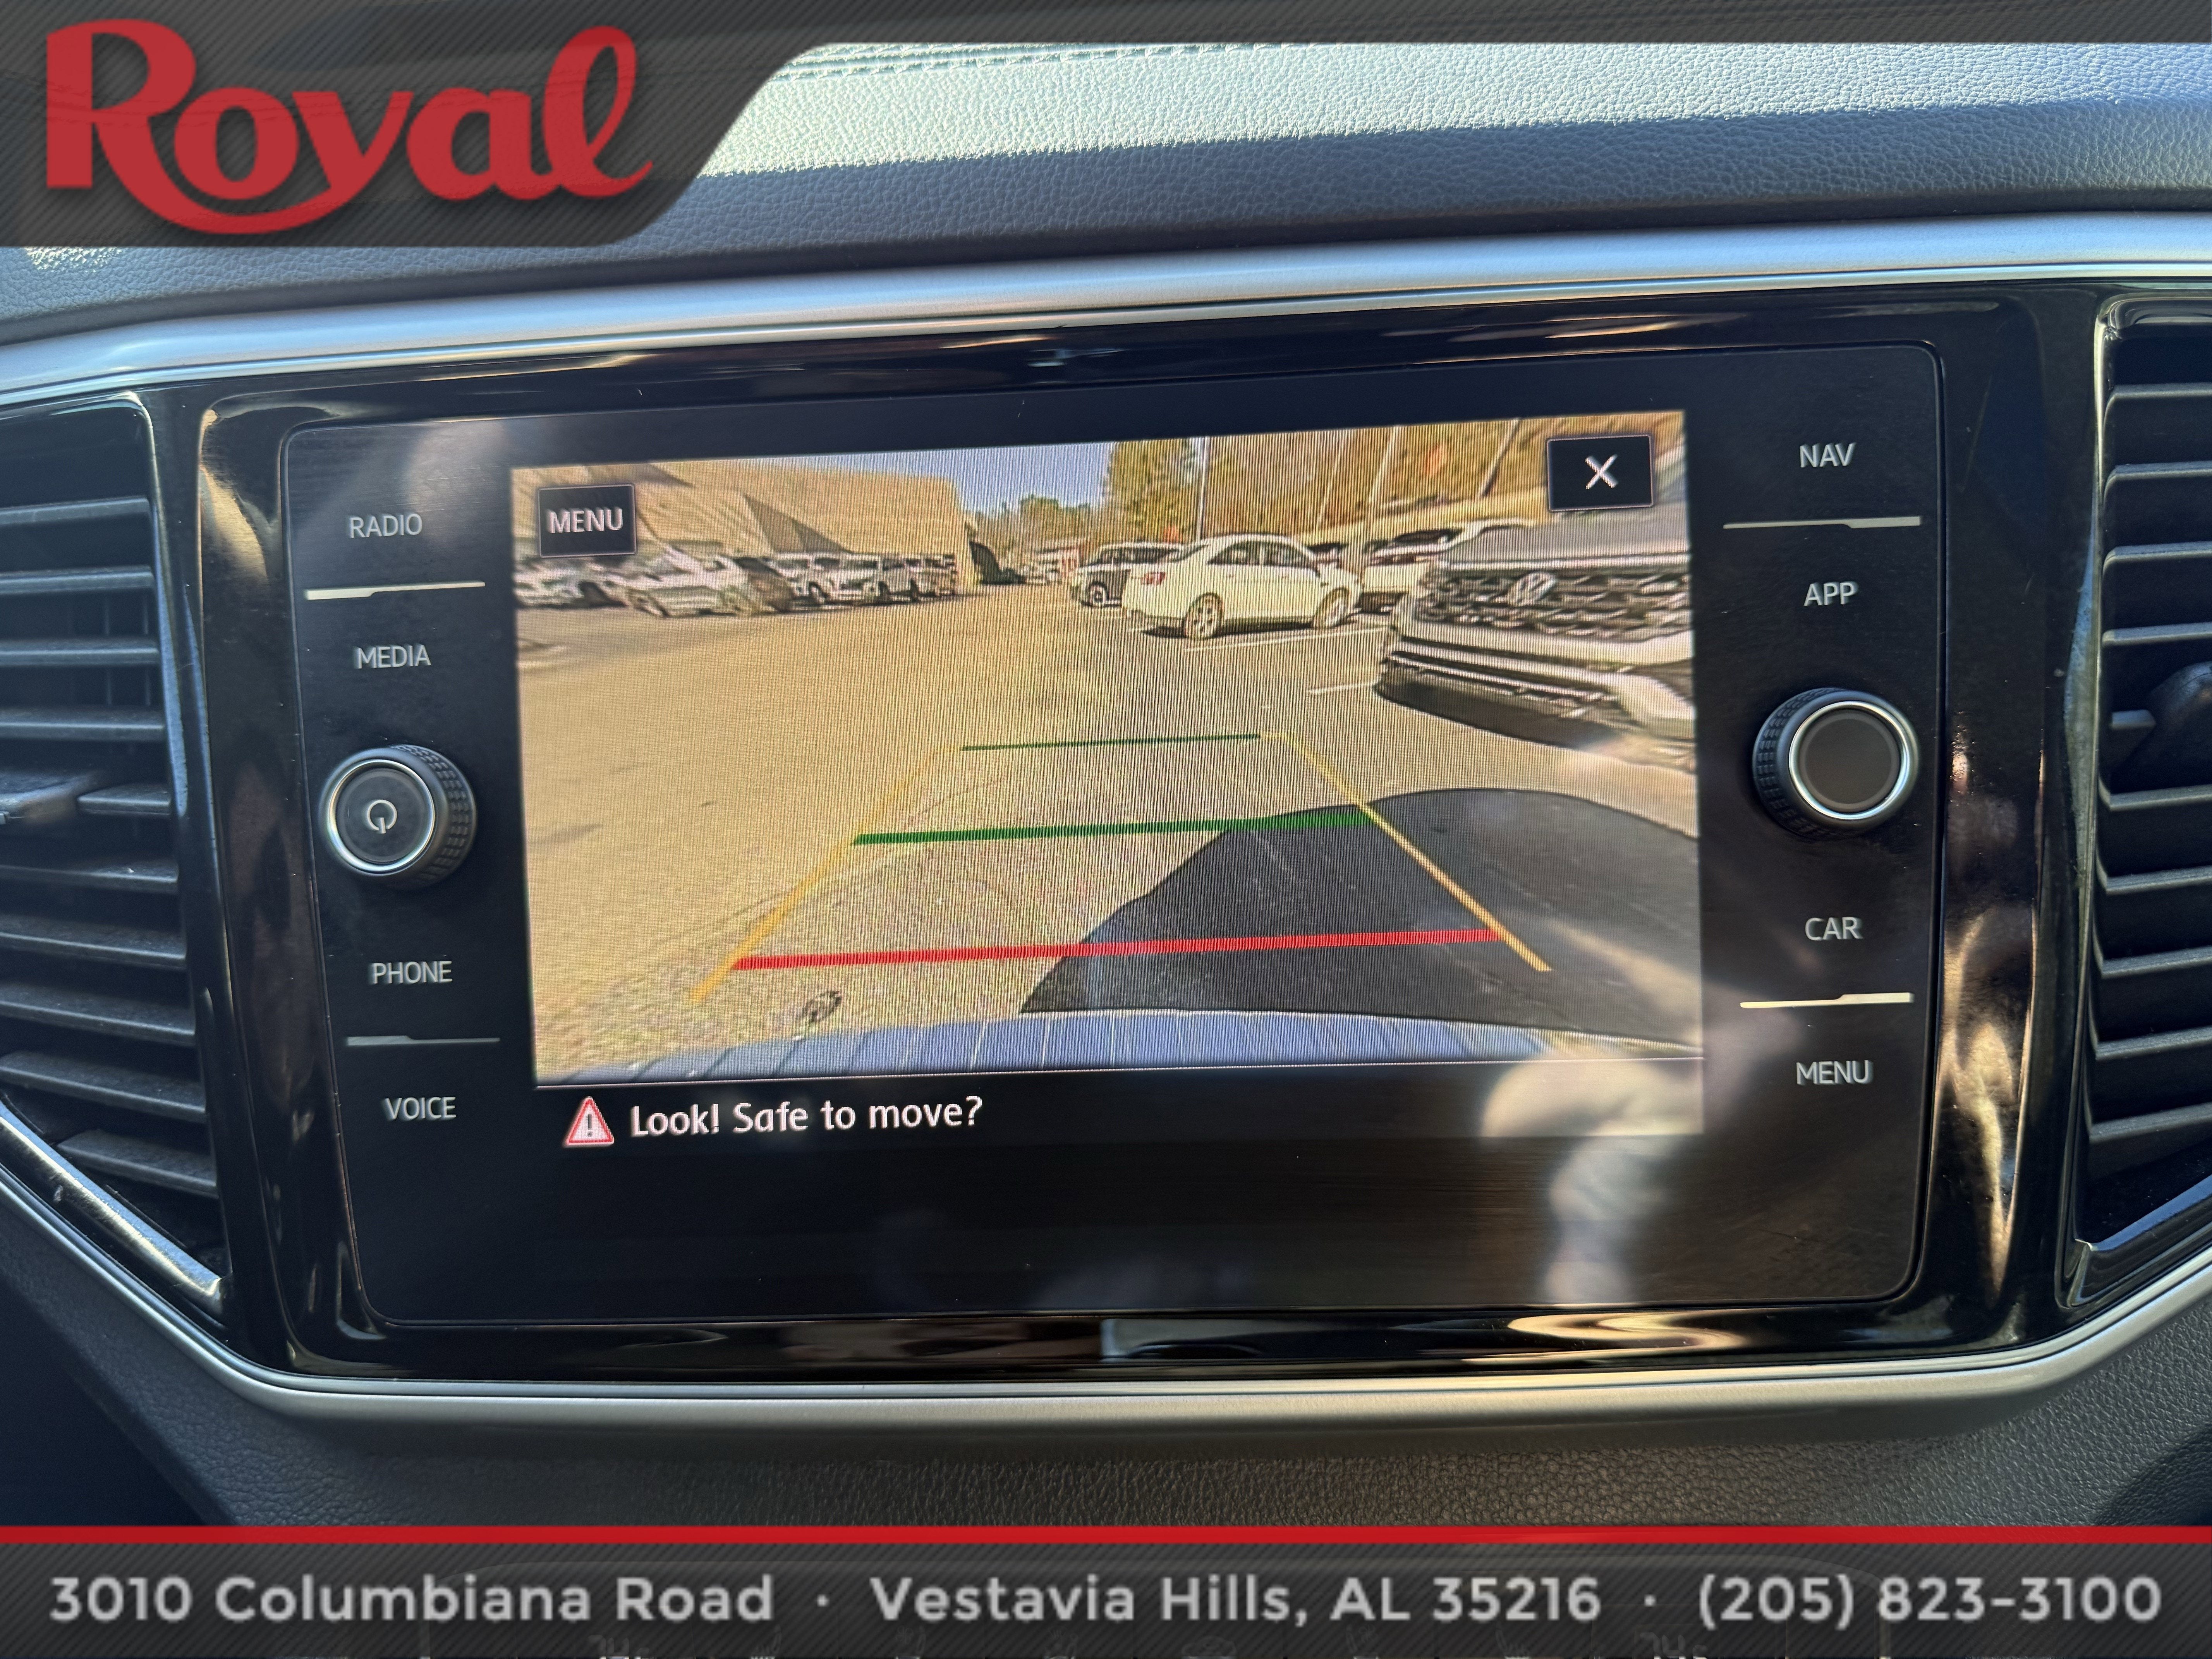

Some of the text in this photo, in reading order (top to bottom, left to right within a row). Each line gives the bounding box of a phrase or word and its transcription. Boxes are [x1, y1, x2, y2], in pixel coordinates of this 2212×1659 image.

[1800, 443, 1855, 468] NAV
[349, 514, 423, 538] RADIO
[547, 508, 623, 534] MENU
[1803, 582, 1858, 606] APP
[355, 644, 432, 669] MEDIA
[1805, 916, 1863, 941] CAR
[371, 960, 453, 984] PHONE
[1796, 1060, 1872, 1085] MENU
[384, 1096, 457, 1120] VOICE
[630, 1095, 983, 1137] Look! Safe to move?
